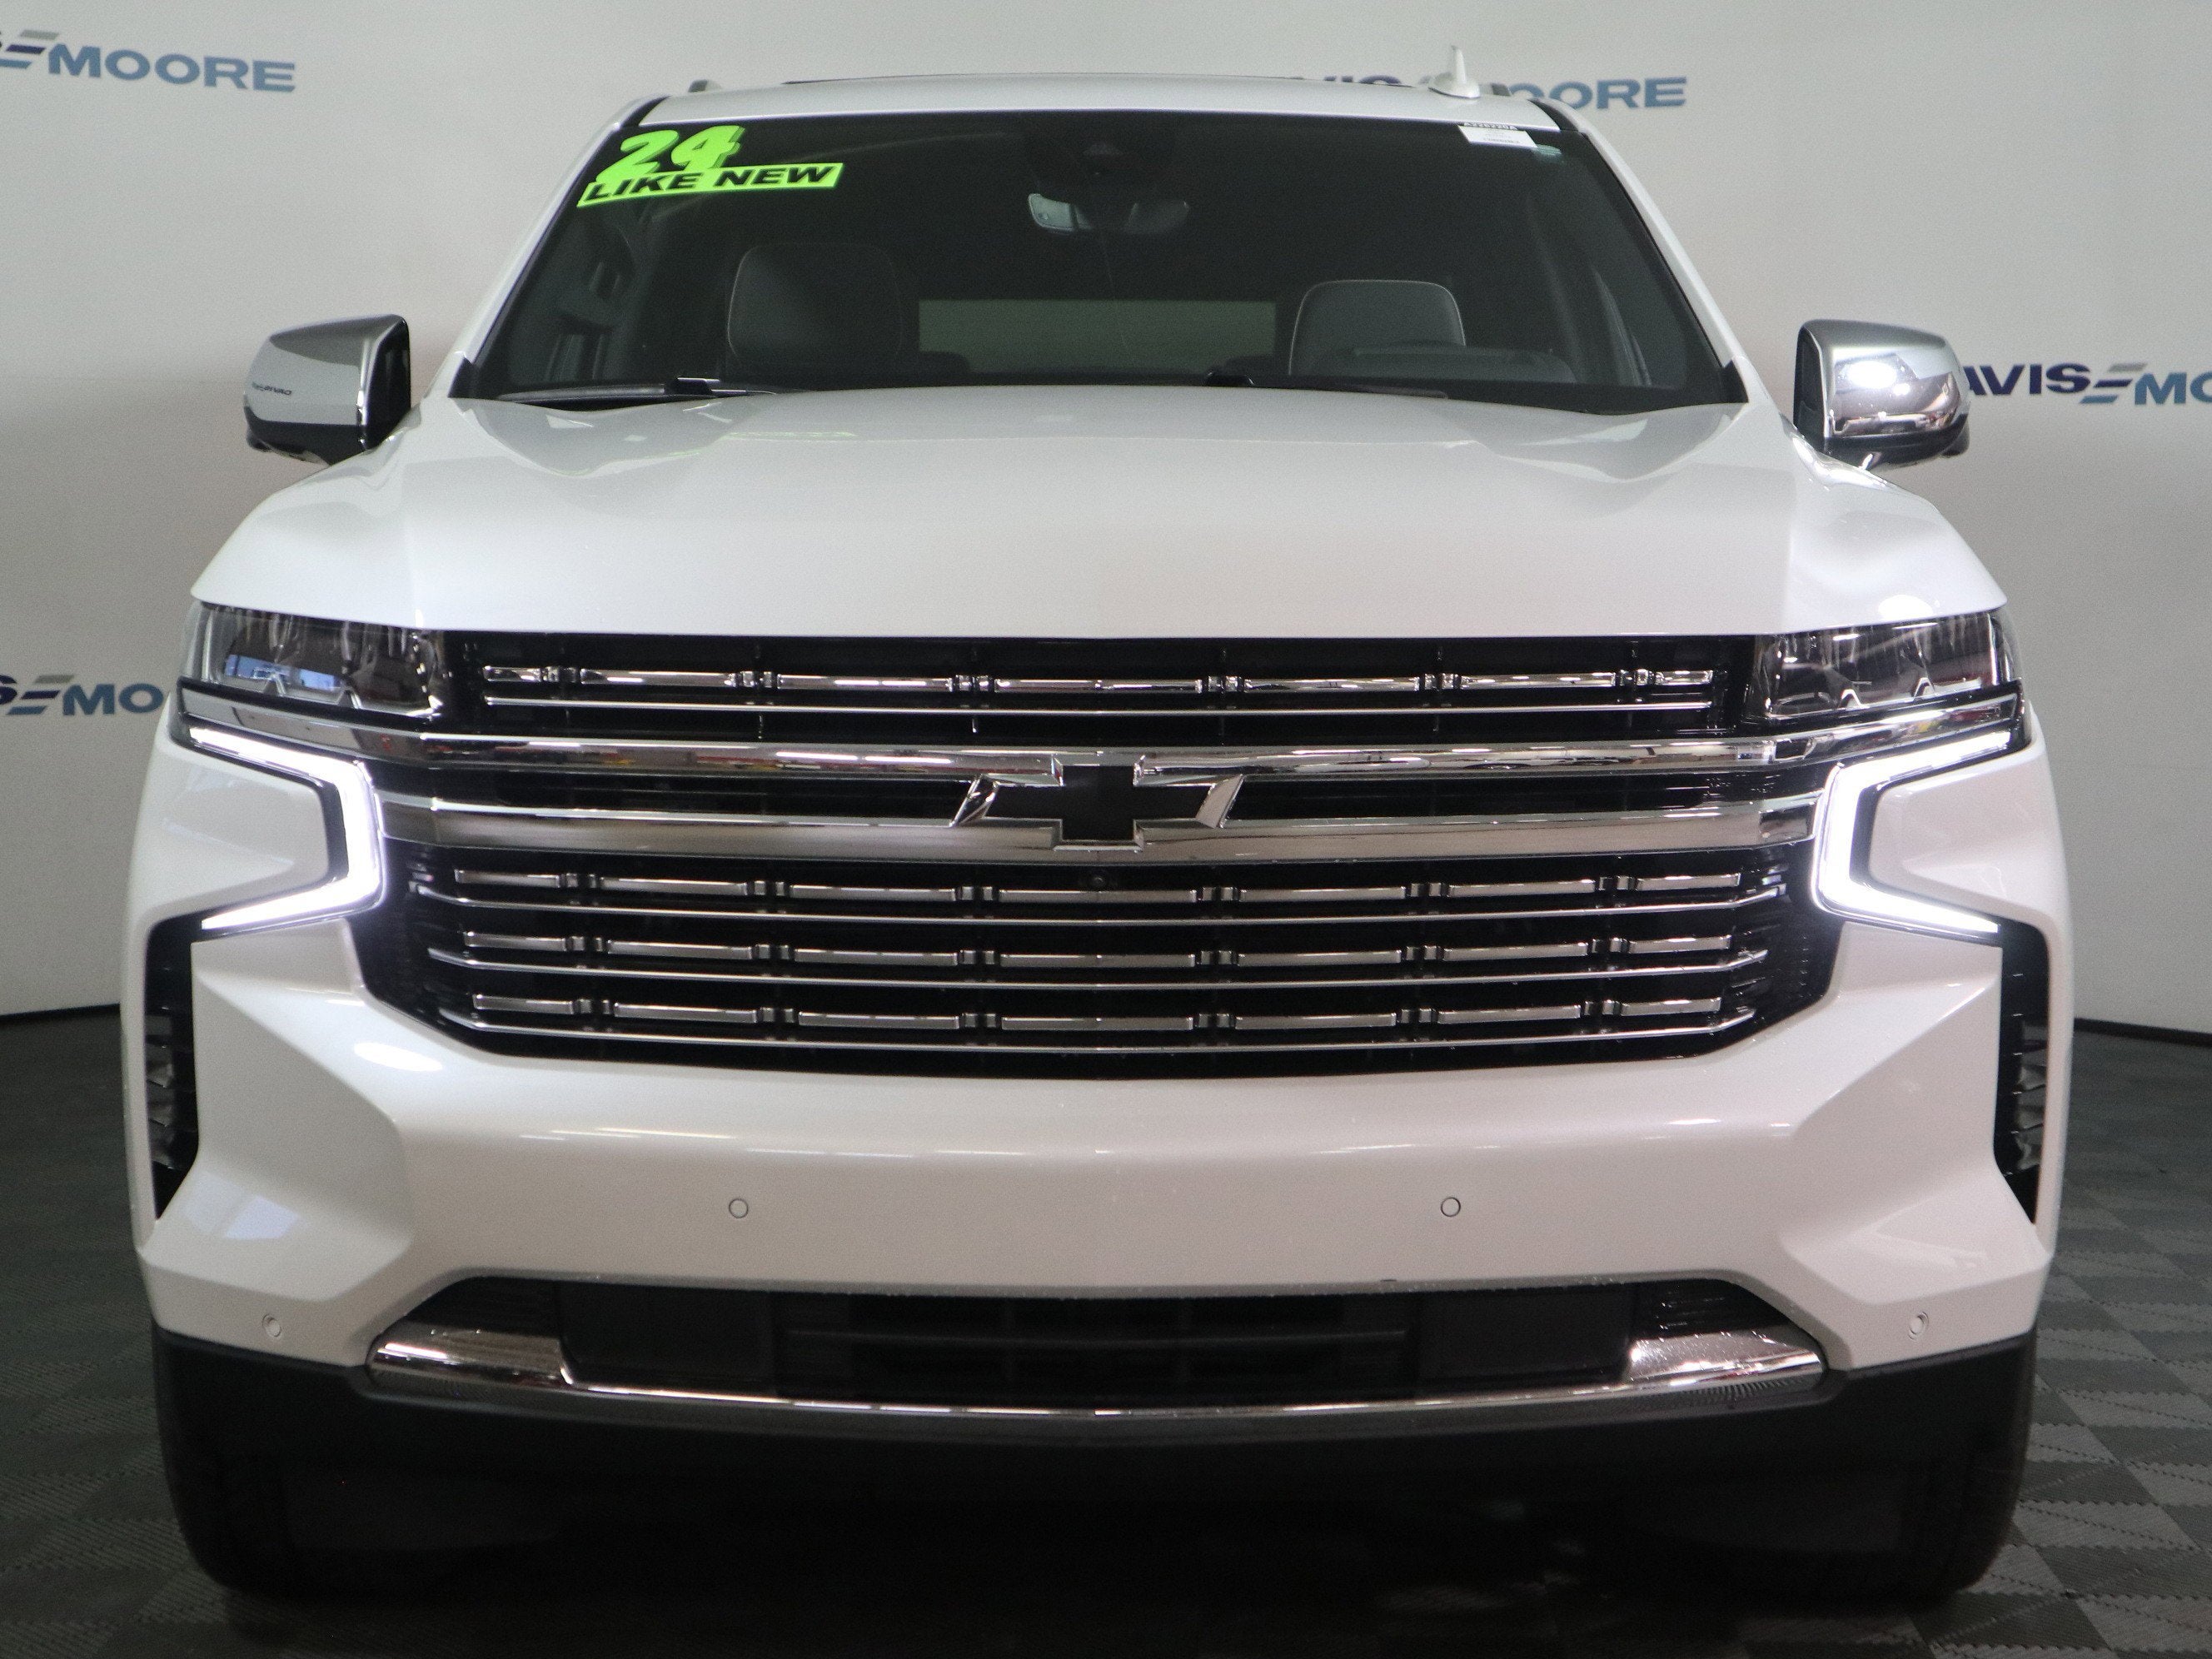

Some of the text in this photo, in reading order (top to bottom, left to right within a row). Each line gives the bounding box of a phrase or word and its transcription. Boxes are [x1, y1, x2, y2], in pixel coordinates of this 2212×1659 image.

[47, 43, 296, 92] MOORE
[595, 124, 745, 182] 24
[582, 166, 837, 202] LIKE NEW
